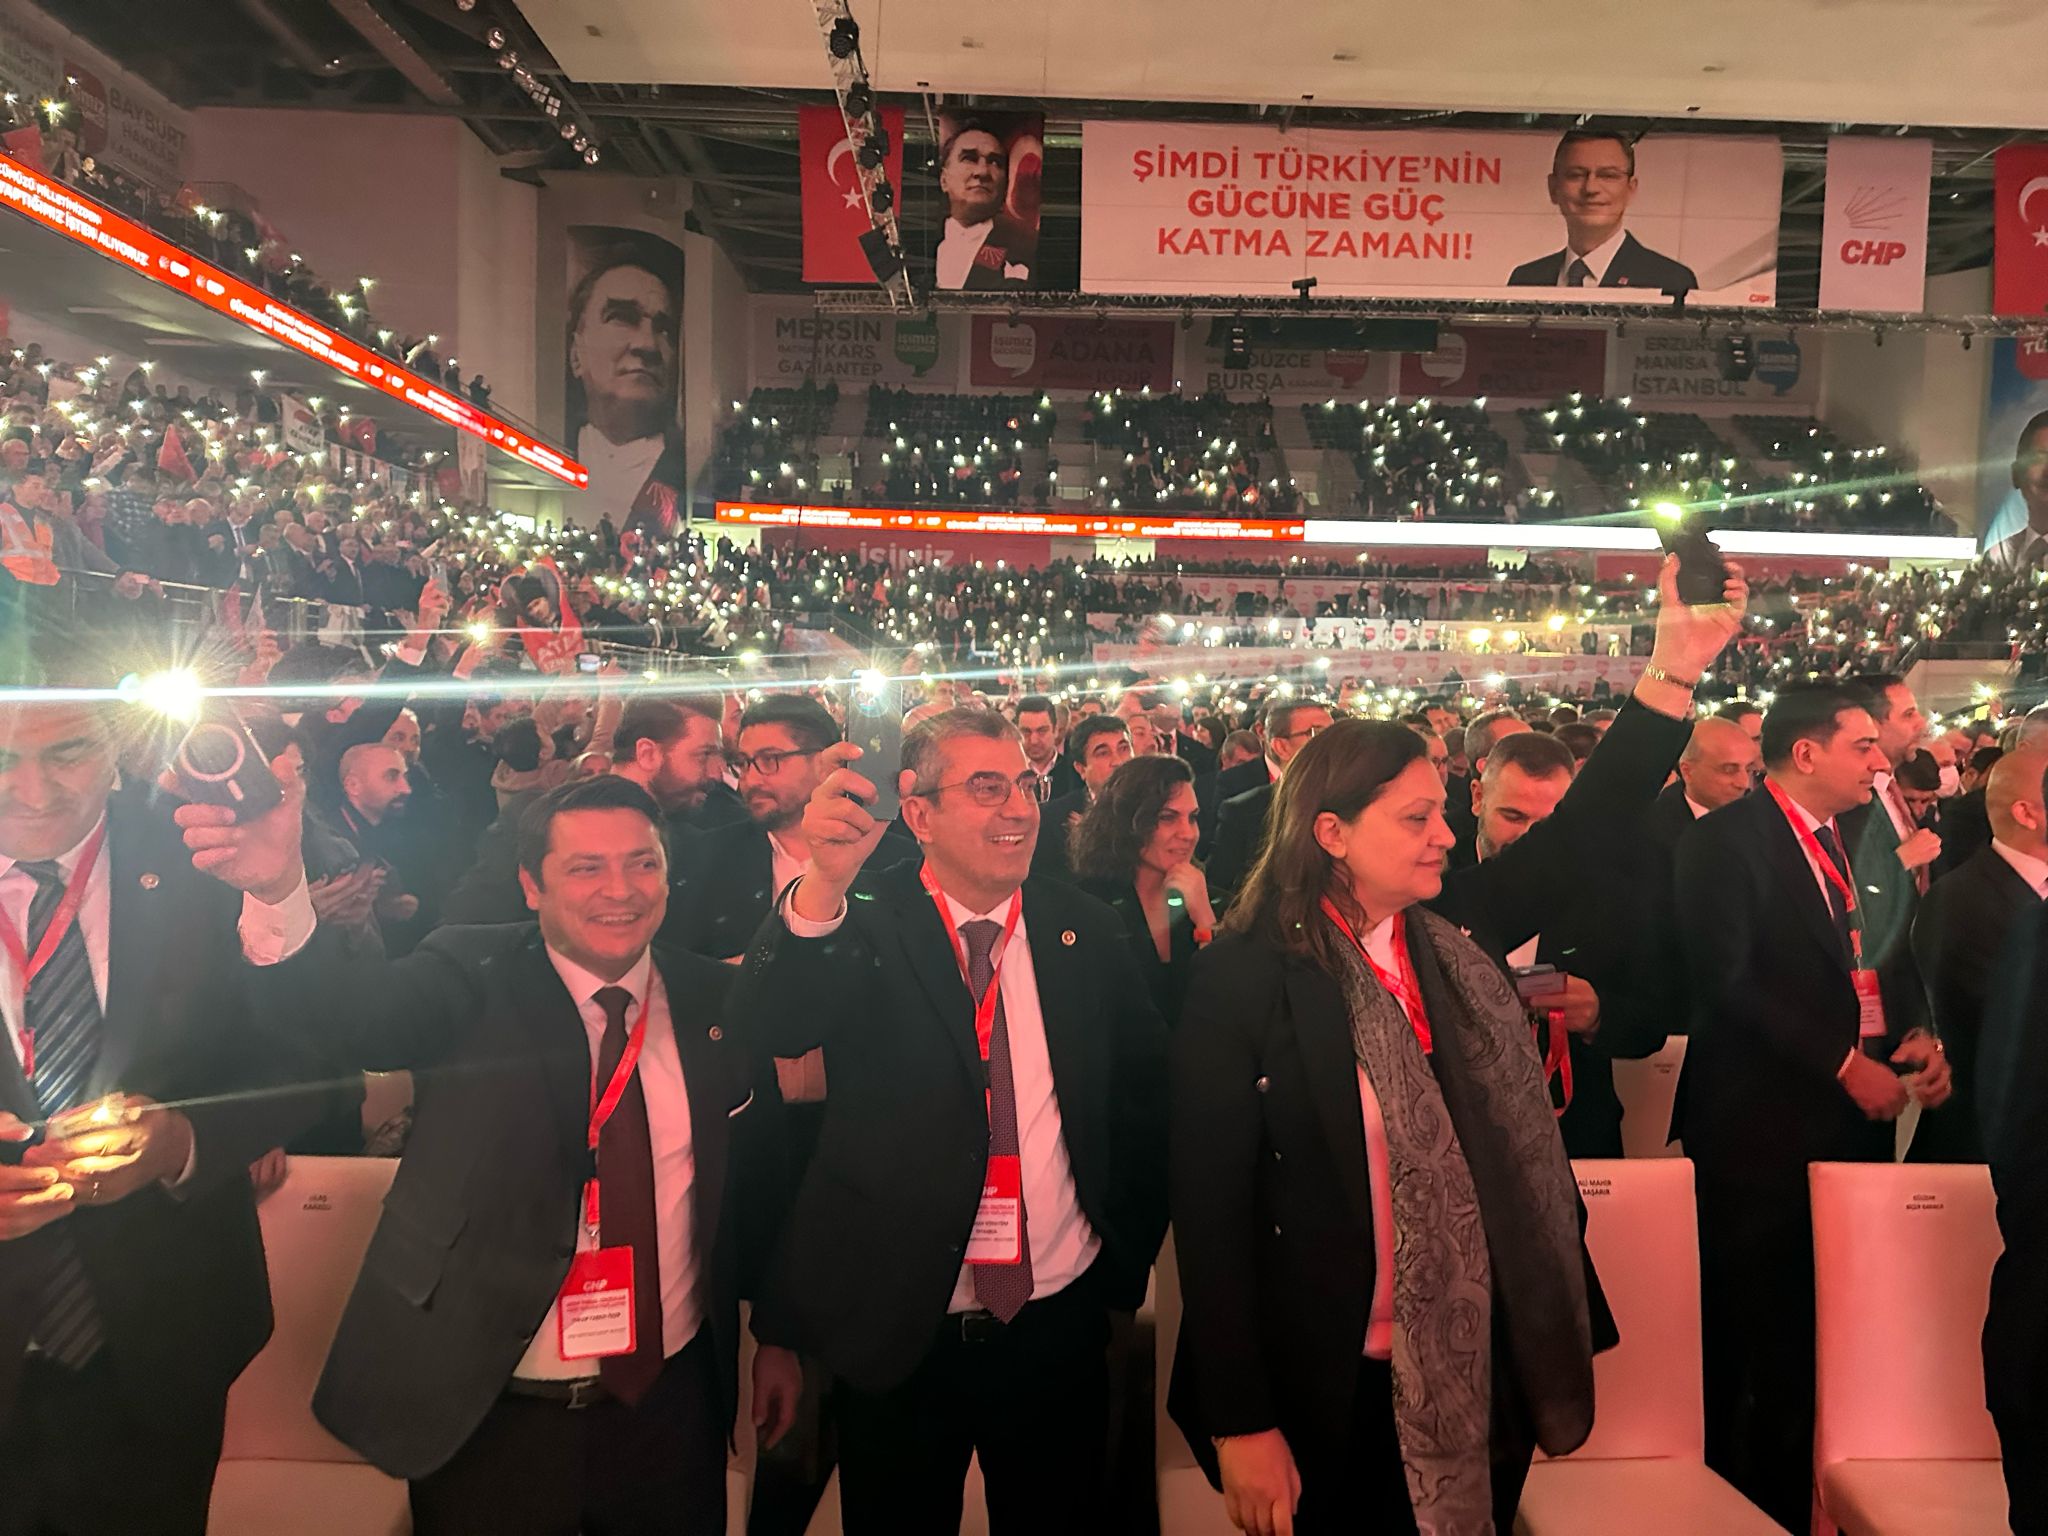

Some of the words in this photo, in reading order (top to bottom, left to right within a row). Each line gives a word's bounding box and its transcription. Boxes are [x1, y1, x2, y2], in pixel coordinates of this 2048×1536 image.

[1132, 143, 1239, 182] ŞİMDİ
[1254, 147, 1501, 184] TÜRKİYE'NİN
[1187, 184, 1351, 220] GÜCÜNE
[1363, 188, 1445, 226] GÜÇ
[1157, 227, 1292, 257] KATMA
[1305, 230, 1473, 260] ZAMANI!
[1840, 239, 1907, 266] CHP
[776, 316, 881, 342] MERSİN
[824, 343, 876, 360] KARS
[1207, 372, 1285, 391] BURSA
